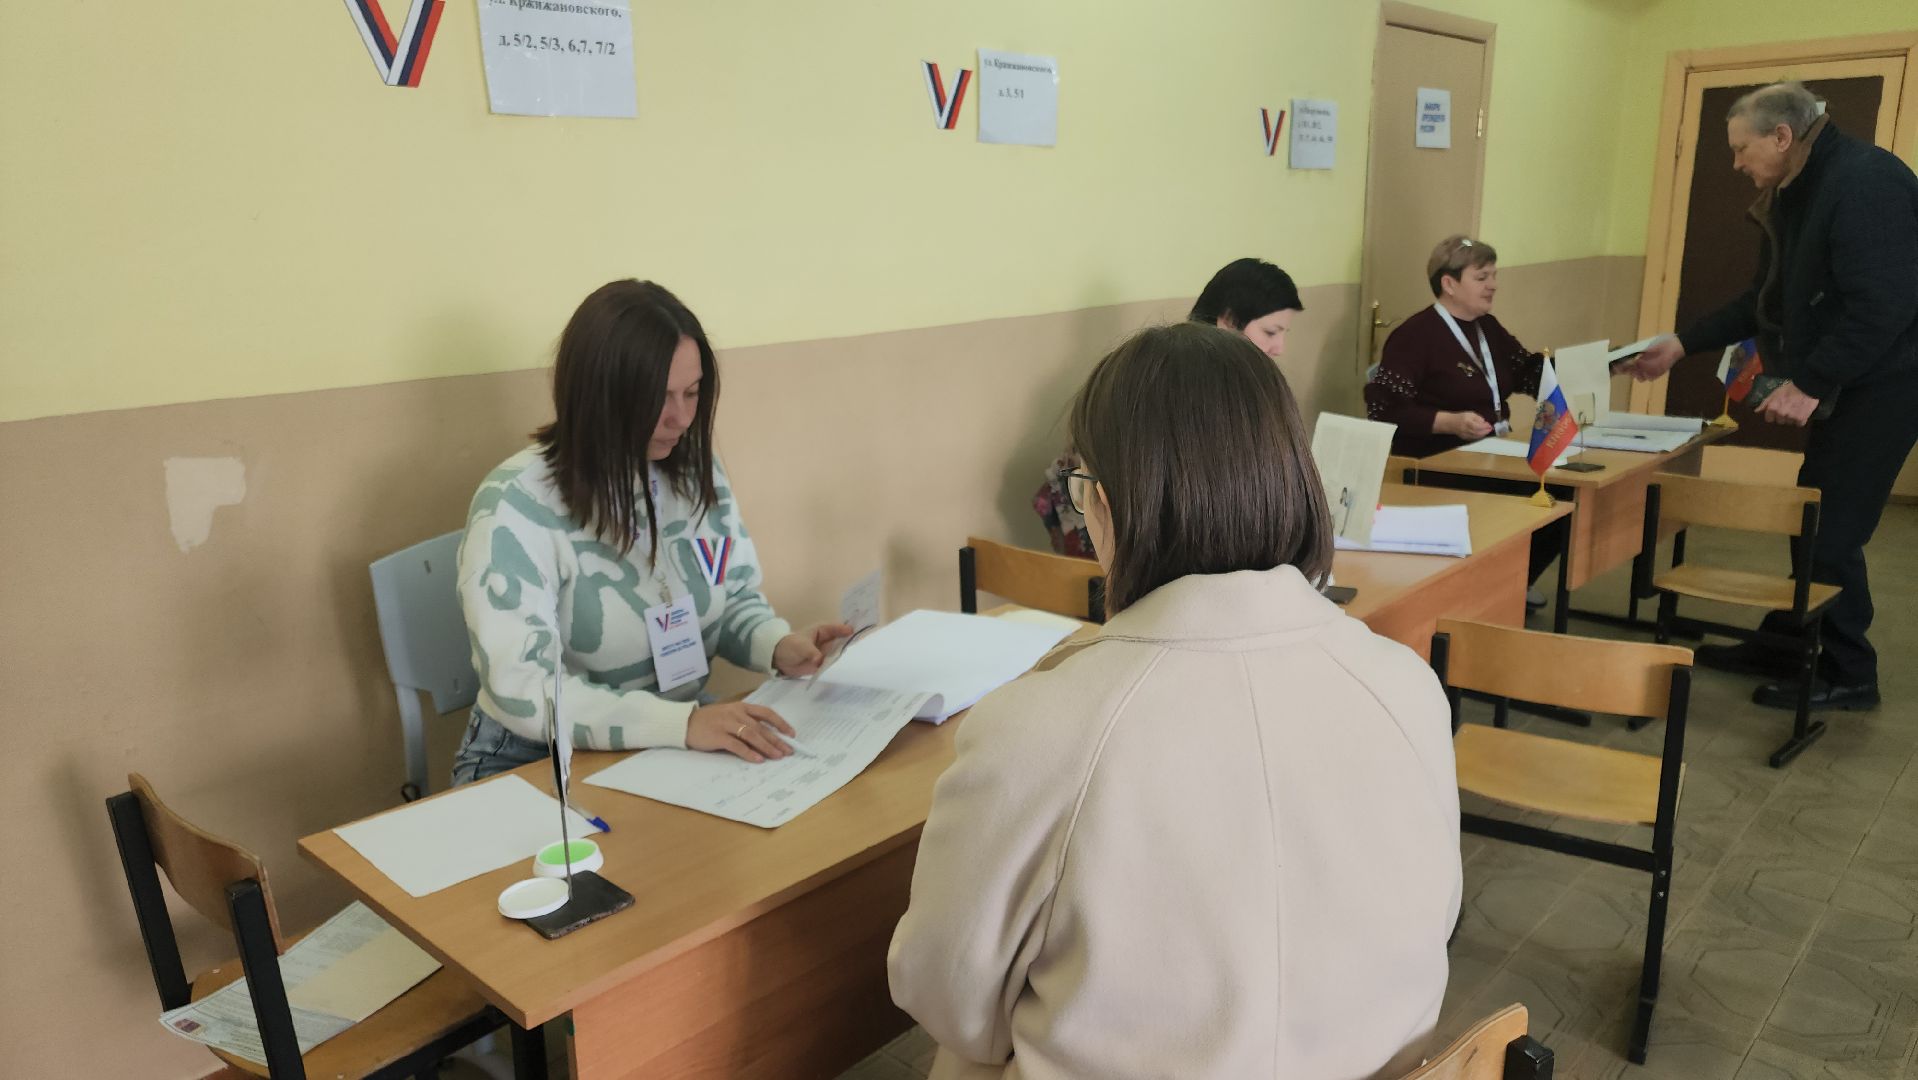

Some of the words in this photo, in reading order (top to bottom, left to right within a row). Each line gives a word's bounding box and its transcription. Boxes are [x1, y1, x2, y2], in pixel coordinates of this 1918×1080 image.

[513, 33, 537, 49] 5/2,
[540, 35, 564, 52] 5/3,
[568, 39, 592, 54] 6,7,
[595, 41, 615, 55] 7/2
